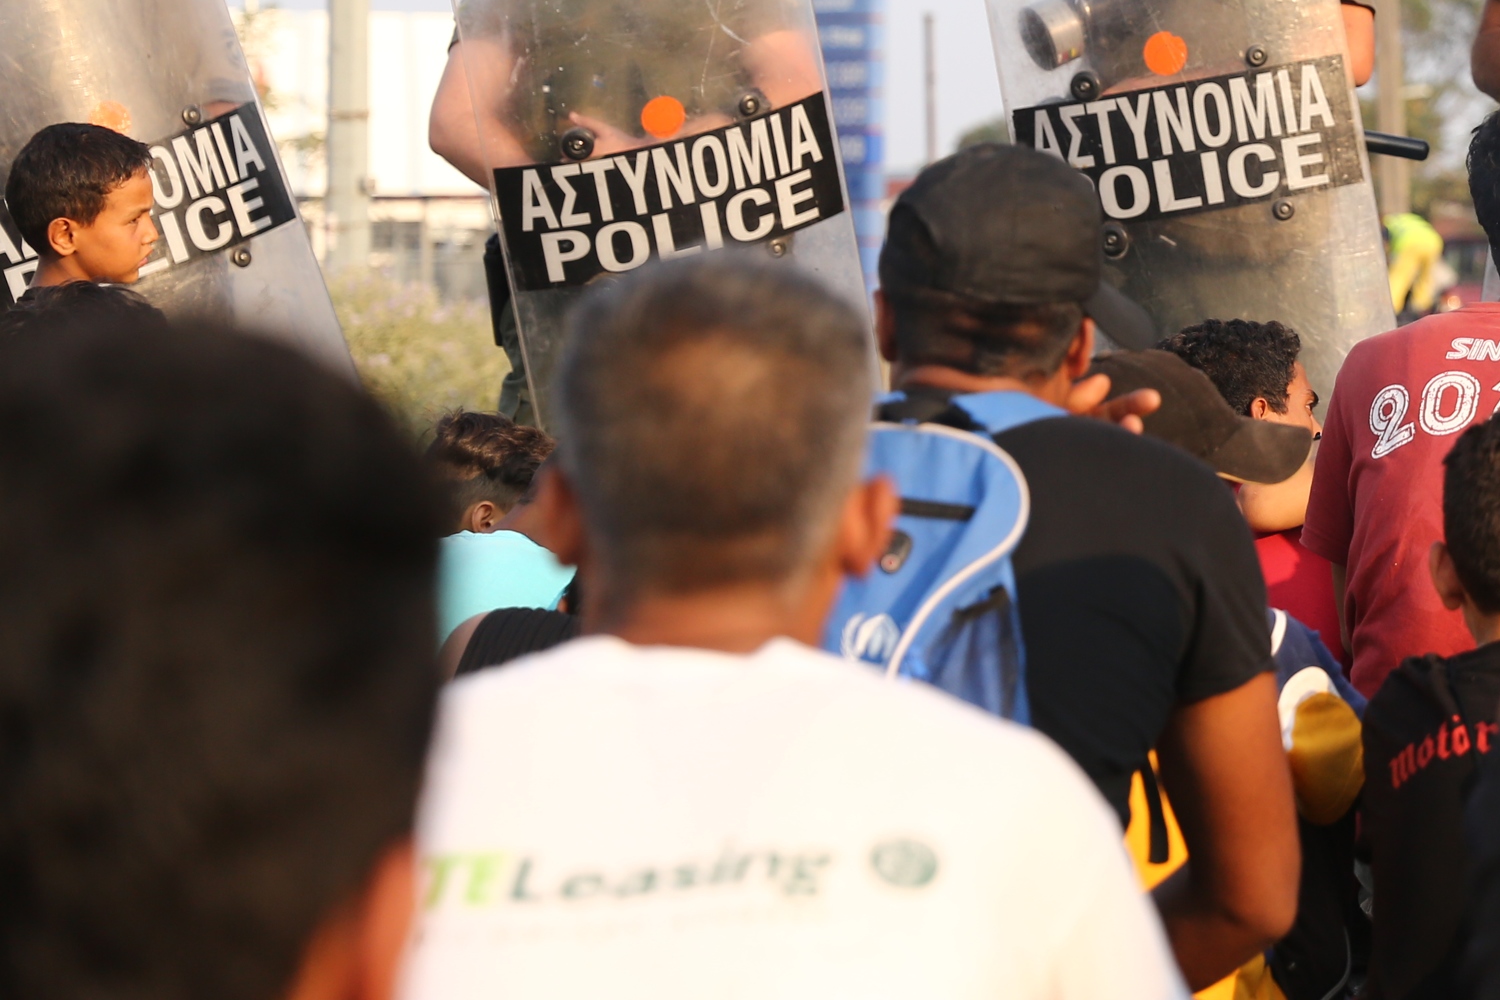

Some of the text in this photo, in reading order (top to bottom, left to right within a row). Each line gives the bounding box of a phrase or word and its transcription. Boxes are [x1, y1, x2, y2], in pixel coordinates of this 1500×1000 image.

[522, 103, 823, 232] ΑΣΤΥΝΟΜΙΑ
[1077, 133, 1331, 219] OLICE
[540, 169, 820, 283] POLICE
